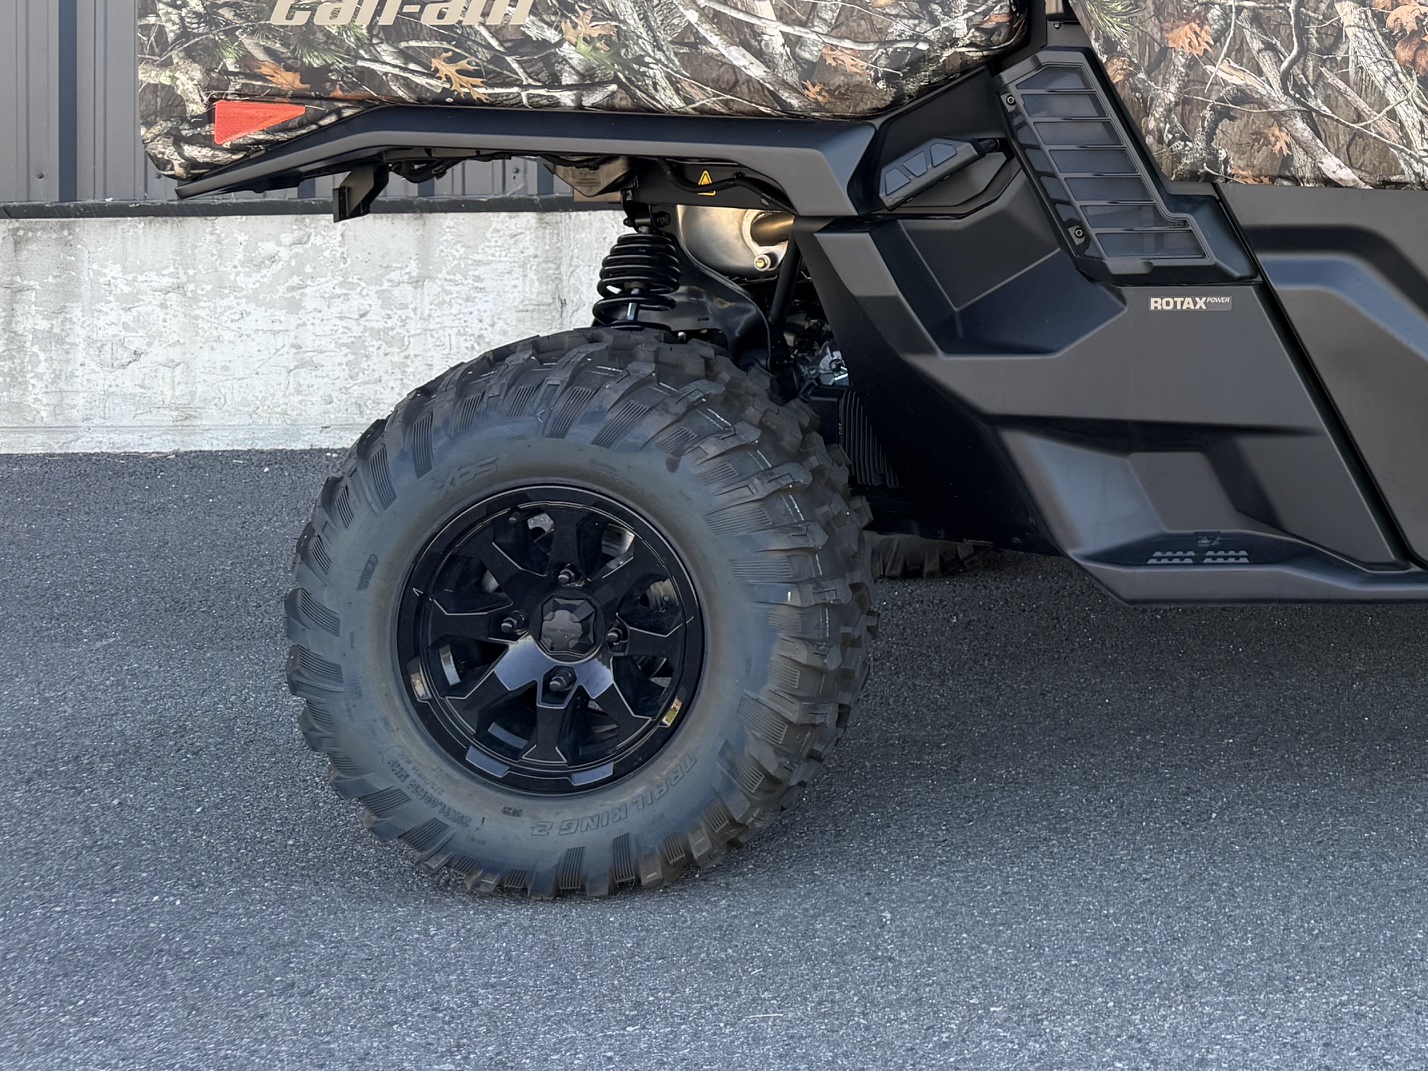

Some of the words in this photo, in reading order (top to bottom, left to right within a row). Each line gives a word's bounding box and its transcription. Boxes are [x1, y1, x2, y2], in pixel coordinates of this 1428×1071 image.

[1150, 297, 1207, 310] ROTAX
[630, 751, 697, 813] TRAIL
[530, 819, 553, 836] 2
[559, 802, 628, 836] KING
